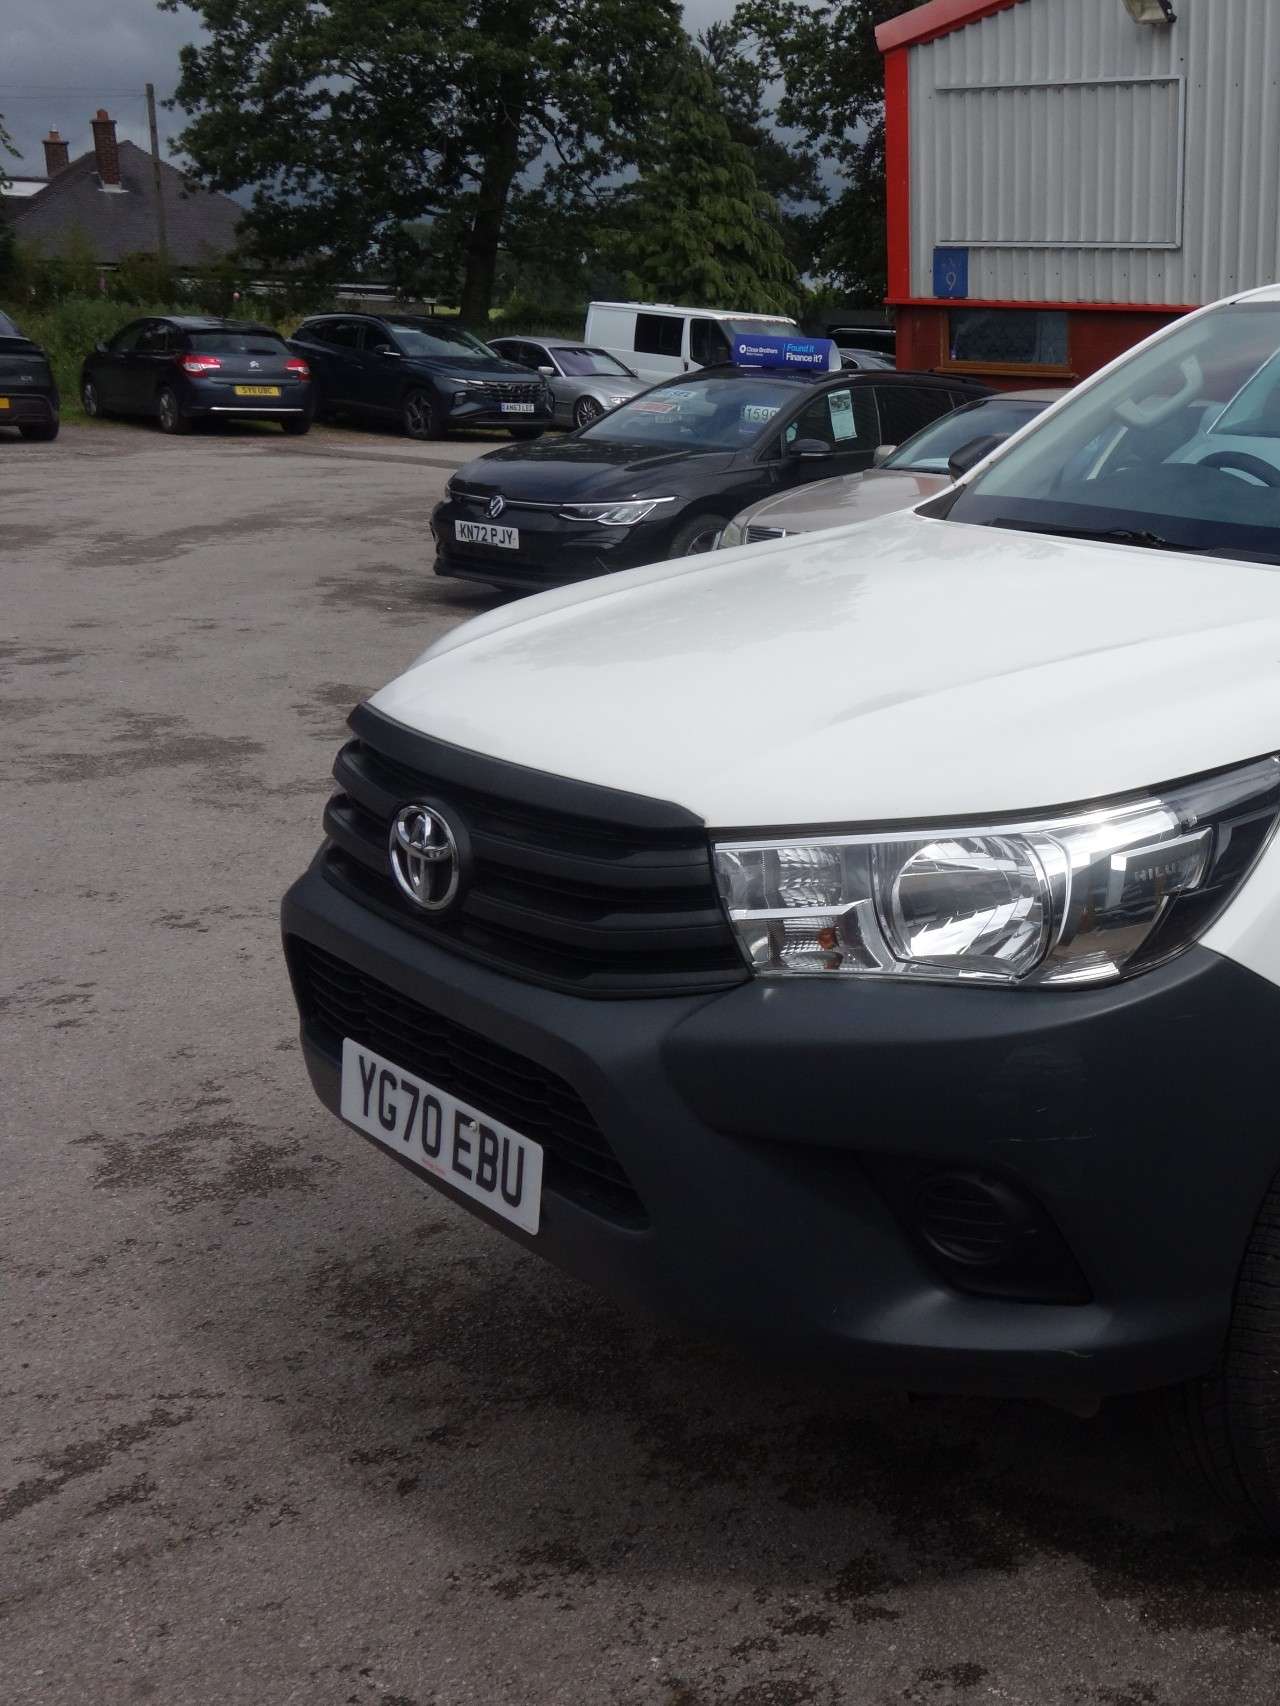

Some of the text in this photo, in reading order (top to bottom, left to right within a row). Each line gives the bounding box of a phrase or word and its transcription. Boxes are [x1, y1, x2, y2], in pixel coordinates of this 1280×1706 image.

[786, 343, 816, 353] Found it
[785, 352, 823, 363] Finance it?
[460, 523, 513, 544] KN72 PJY
[358, 1054, 525, 1208] YG70 EBU
